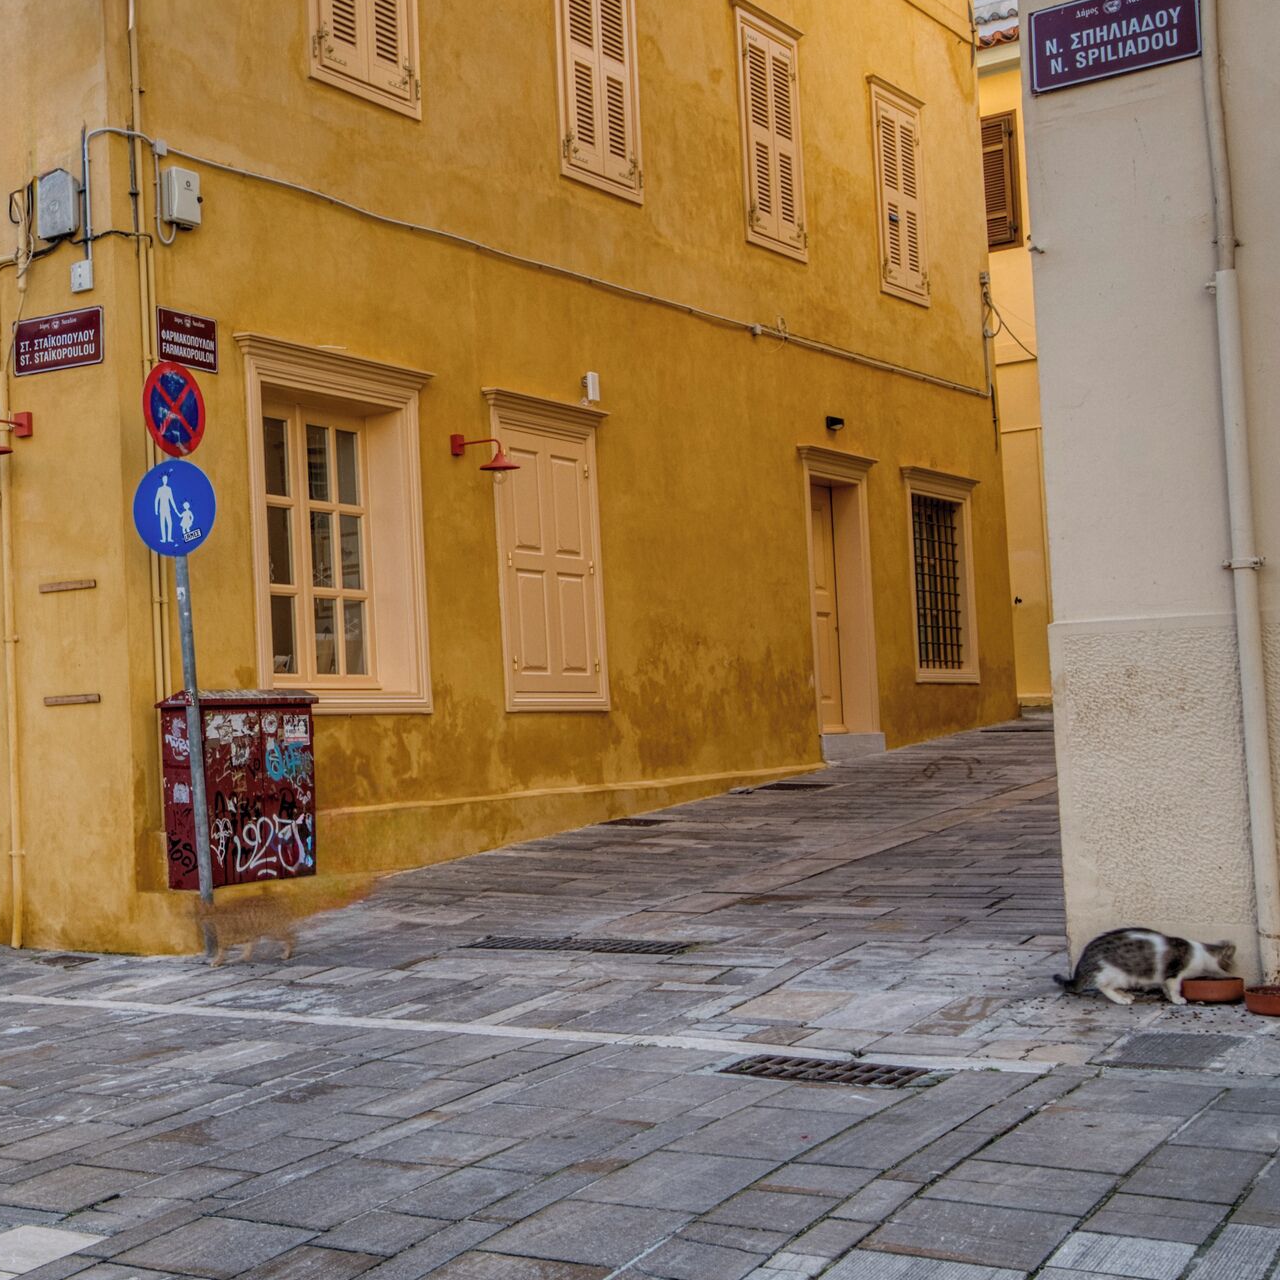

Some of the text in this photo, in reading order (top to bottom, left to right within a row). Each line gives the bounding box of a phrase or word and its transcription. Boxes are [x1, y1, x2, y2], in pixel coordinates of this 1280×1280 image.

[1075, 7, 1099, 19] Δήμος
[1045, 5, 1182, 56] Ν. ΣΠΗΛΙΑΔΟΥ
[1050, 29, 1179, 75] N. SPILIADOU
[20, 329, 95, 353] ΣΤ. ΣΤΑΪΚΟΠΟΥΛΟΥ
[161, 329, 215, 351] ΦΑΡΜΑΚΟΠΟΥΛΩΝ
[20, 343, 95, 366] ST. STAÏKOPOULOU
[162, 342, 215, 364] FARMAKOPOULON
